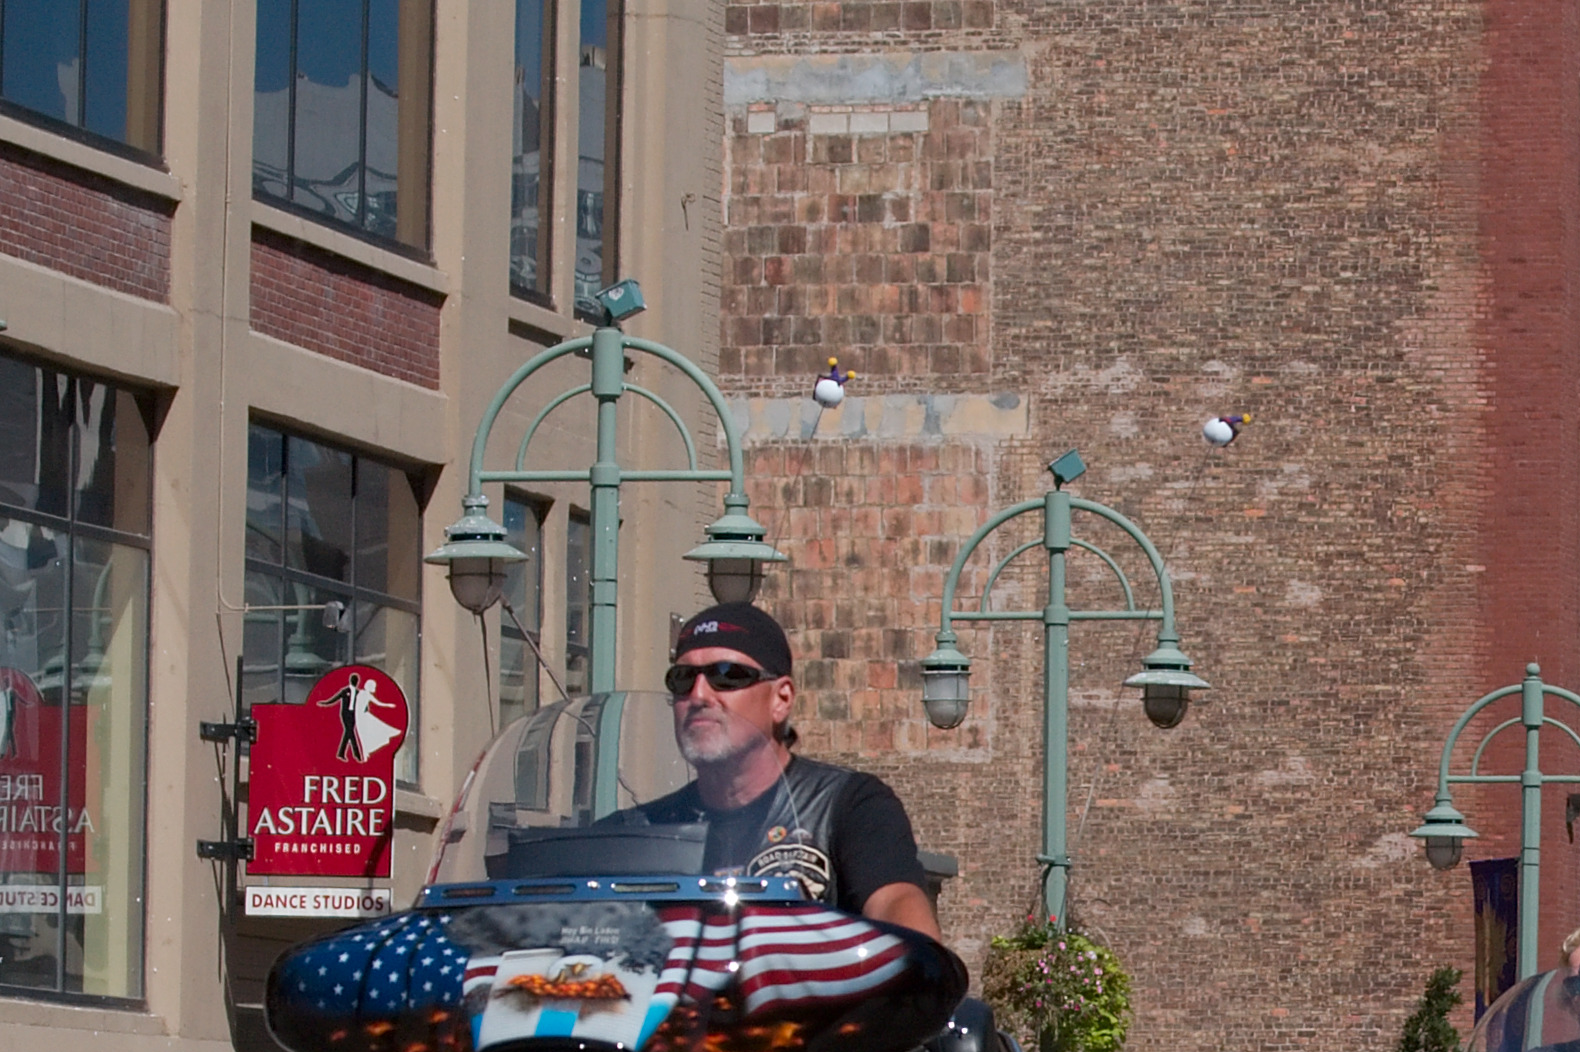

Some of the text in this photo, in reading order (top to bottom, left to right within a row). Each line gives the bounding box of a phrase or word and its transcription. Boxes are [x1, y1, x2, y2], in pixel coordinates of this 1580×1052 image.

[304, 775, 387, 805] FRED
[253, 806, 386, 836] ASTAIRE
[274, 842, 361, 855] FRANCHISED
[251, 893, 384, 911] DANCE STUDIOS
